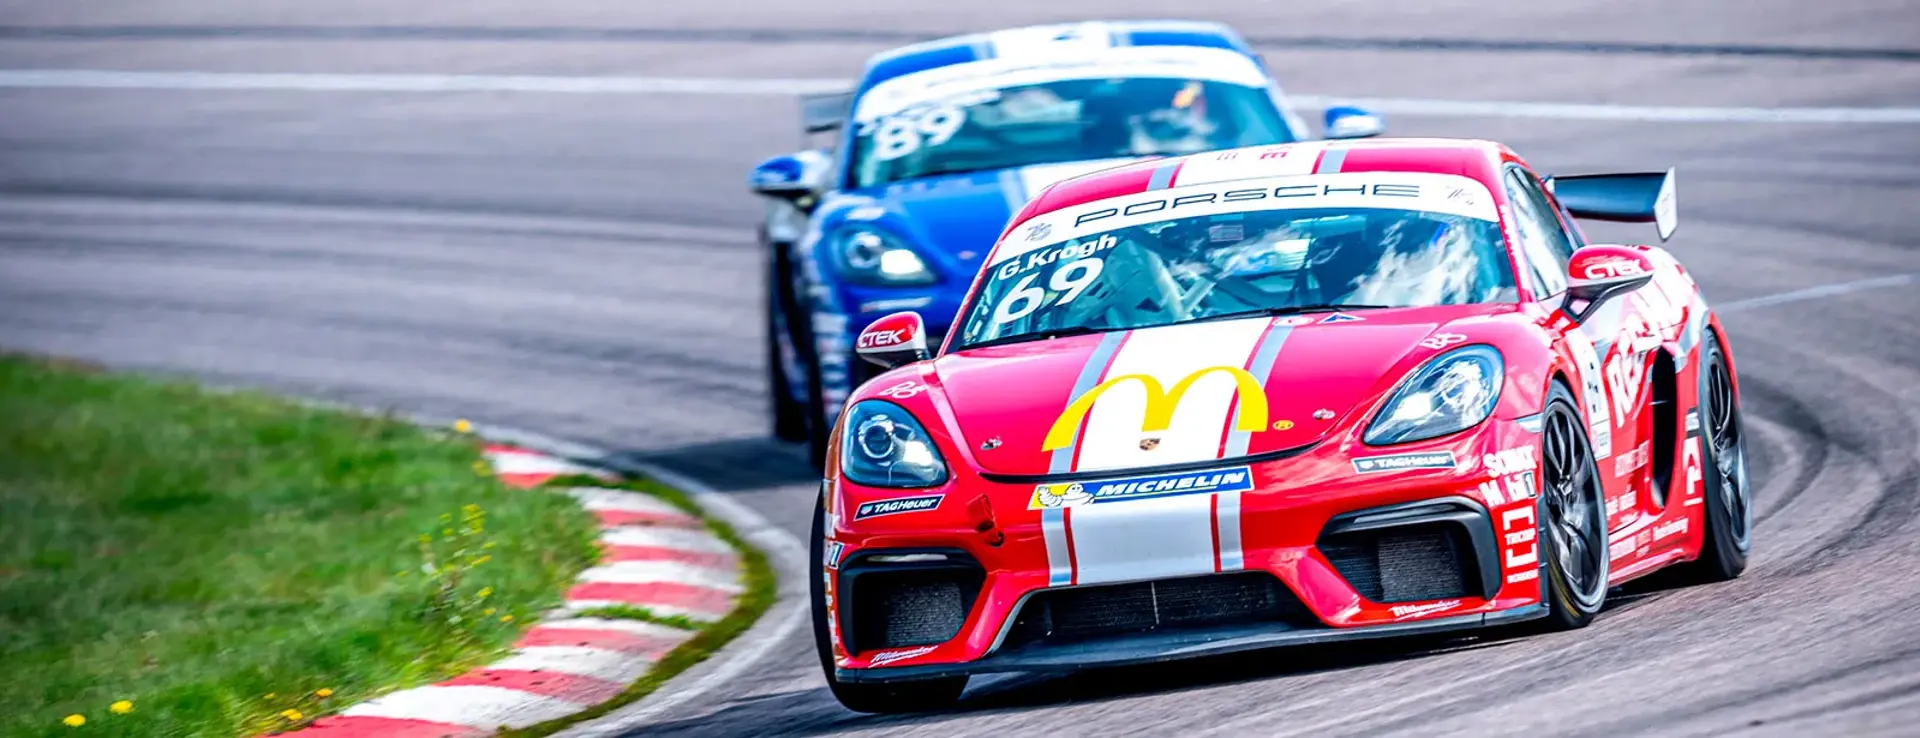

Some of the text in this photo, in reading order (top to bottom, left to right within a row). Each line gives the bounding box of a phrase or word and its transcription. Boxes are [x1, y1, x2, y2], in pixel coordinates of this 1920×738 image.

[873, 107, 966, 161] 89
[1074, 184, 1420, 228] PORSCHE
[998, 233, 1118, 281] G.Krogh
[1584, 259, 1646, 279] CTEK
[992, 257, 1104, 324] 69
[858, 329, 906, 348] CTEK
[1096, 472, 1246, 497] MICHELIN
